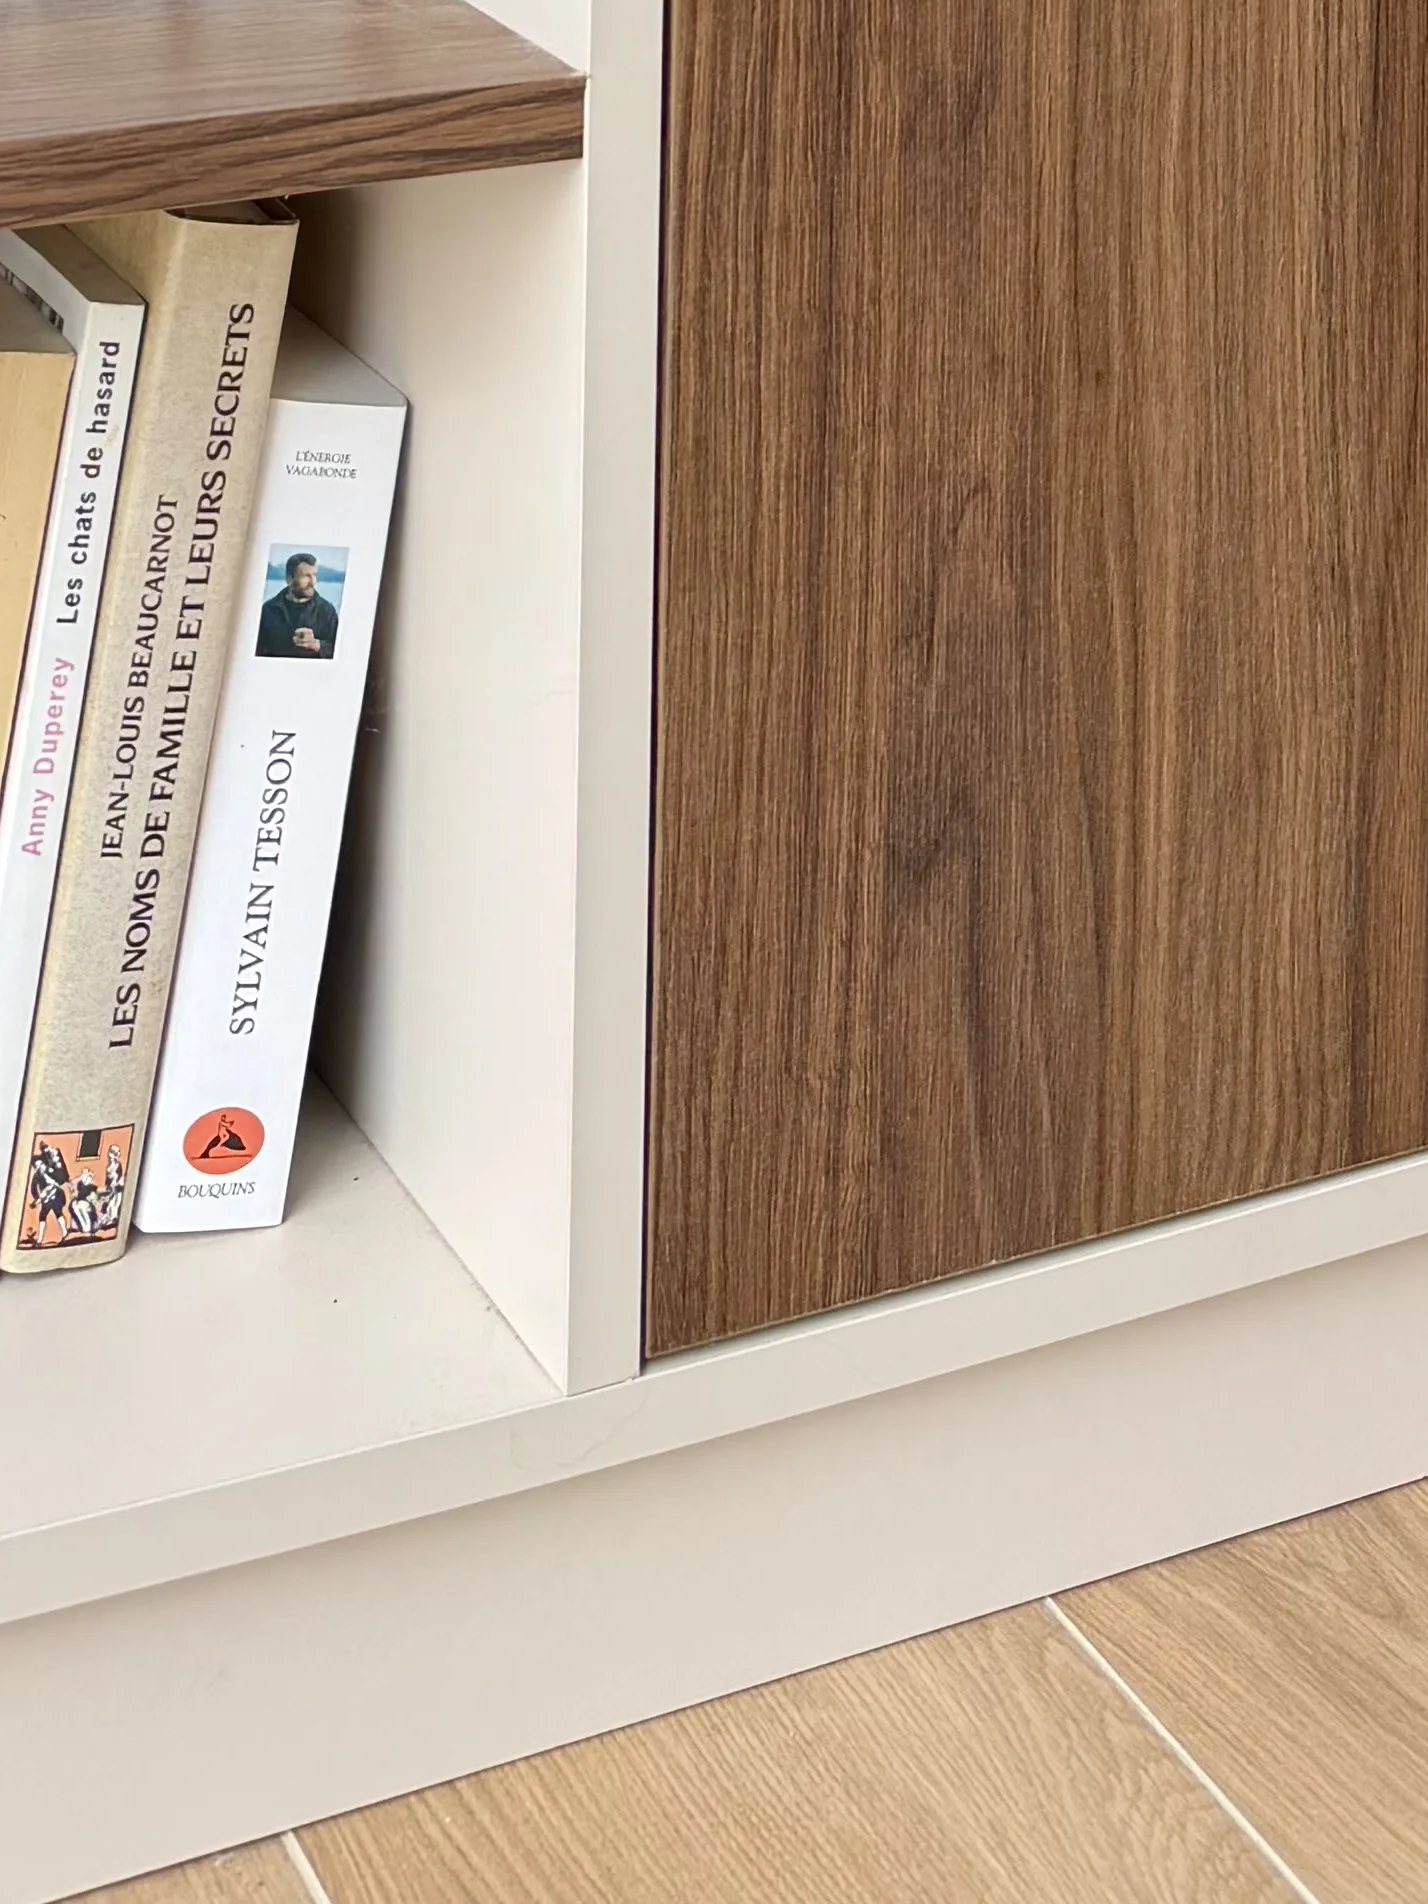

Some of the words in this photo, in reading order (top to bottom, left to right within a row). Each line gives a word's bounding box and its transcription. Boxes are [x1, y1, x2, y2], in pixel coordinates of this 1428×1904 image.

[85, 341, 120, 433] hasard
[206, 303, 254, 460] SECRETS
[79, 447, 103, 479] de
[67, 491, 96, 565] chats
[185, 470, 226, 585] LEURS
[56, 578, 83, 623] Les
[175, 595, 204, 639] ET
[32, 657, 75, 774] Duperey
[100, 696, 144, 858] JEAN-LOUIS
[127, 494, 177, 687] BEAUCARNOT
[148, 650, 197, 801] FAMILLE
[21, 789, 55, 856] Anny
[139, 811, 170, 858] DE
[121, 868, 160, 972] NOMS
[229, 882, 274, 1034] SYLVAIN
[252, 729, 296, 872] TESSON
[109, 983, 141, 1048] LES
[177, 1181, 255, 1199] BOUQUINS
